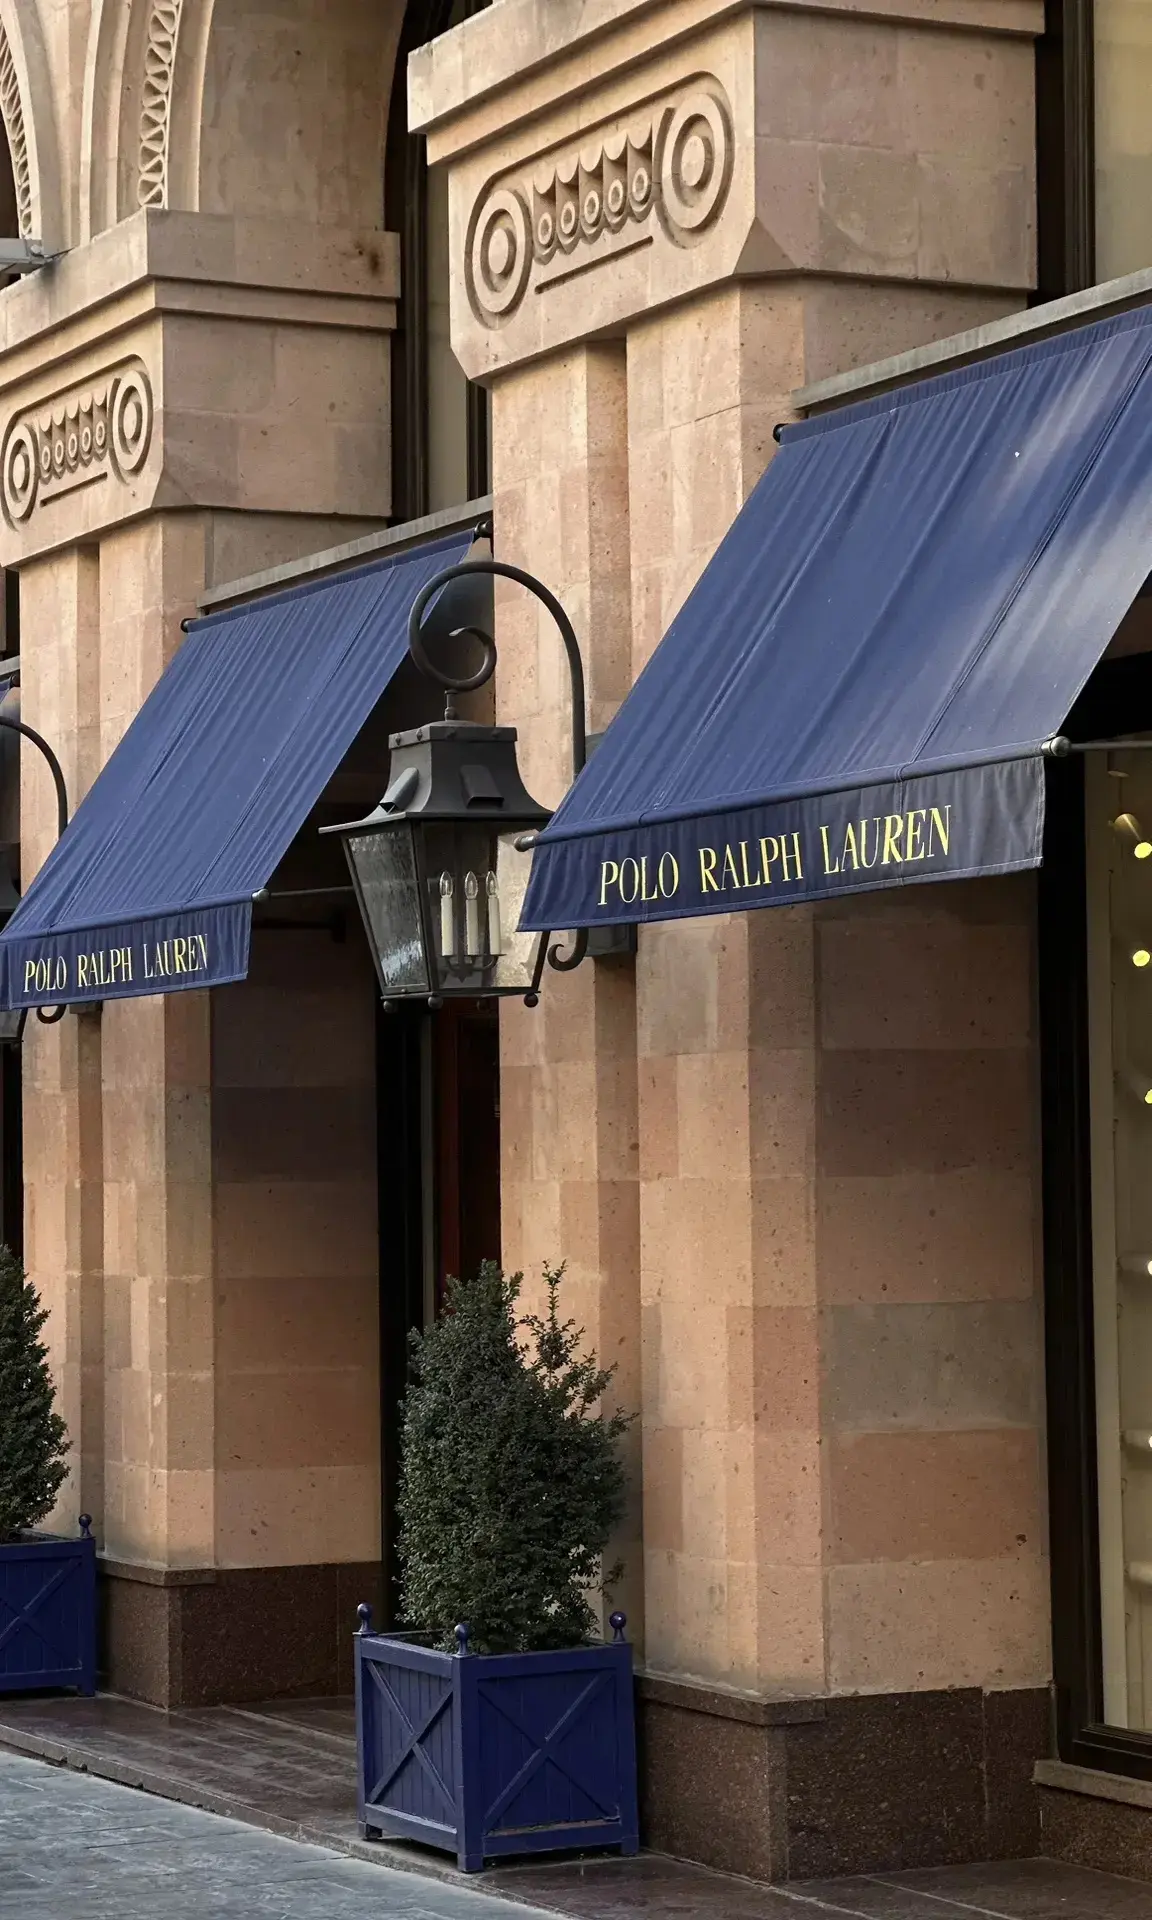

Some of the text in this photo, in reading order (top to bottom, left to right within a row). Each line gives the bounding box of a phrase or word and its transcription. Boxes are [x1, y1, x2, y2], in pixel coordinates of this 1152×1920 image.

[597, 805, 952, 906] POLO RALPH LAUREN
[23, 933, 208, 993] POLO RALPH LAUREN
